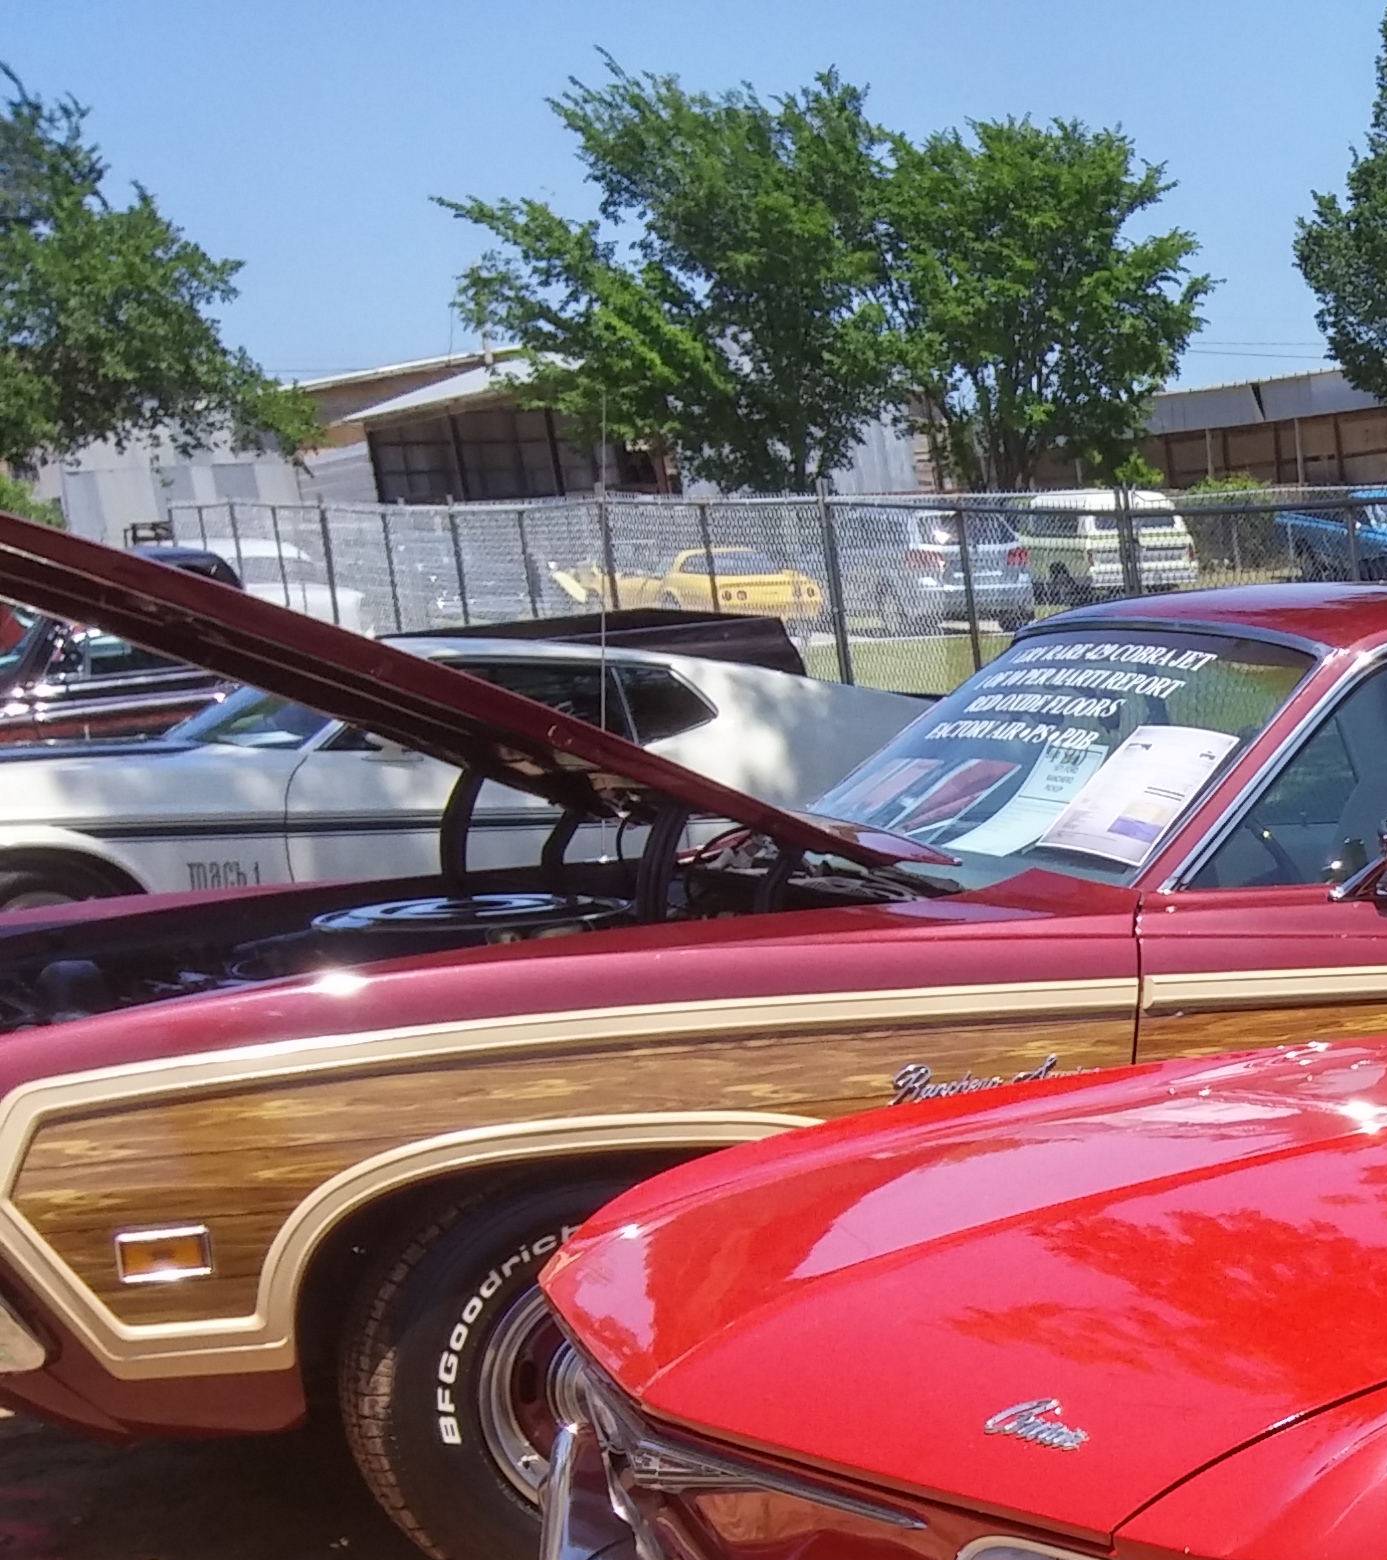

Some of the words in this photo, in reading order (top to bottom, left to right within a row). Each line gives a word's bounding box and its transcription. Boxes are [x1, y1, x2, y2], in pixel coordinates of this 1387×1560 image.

[1041, 643, 1092, 662] RARE
[1111, 644, 1174, 664] COBRA
[1166, 652, 1219, 672] JET
[1015, 668, 1052, 685] PER
[1044, 669, 1106, 689] MARTI
[1105, 675, 1186, 699] REPORT
[963, 696, 1004, 713] RED
[997, 695, 1050, 713] OXIDE
[1043, 698, 1127, 717] FLOORS
[924, 721, 996, 739] FACTORY
[986, 721, 1022, 740] AIR
[1026, 724, 1056, 744] PS
[1053, 727, 1100, 750] PDB
[437, 1225, 583, 1445] BFGoodrich
